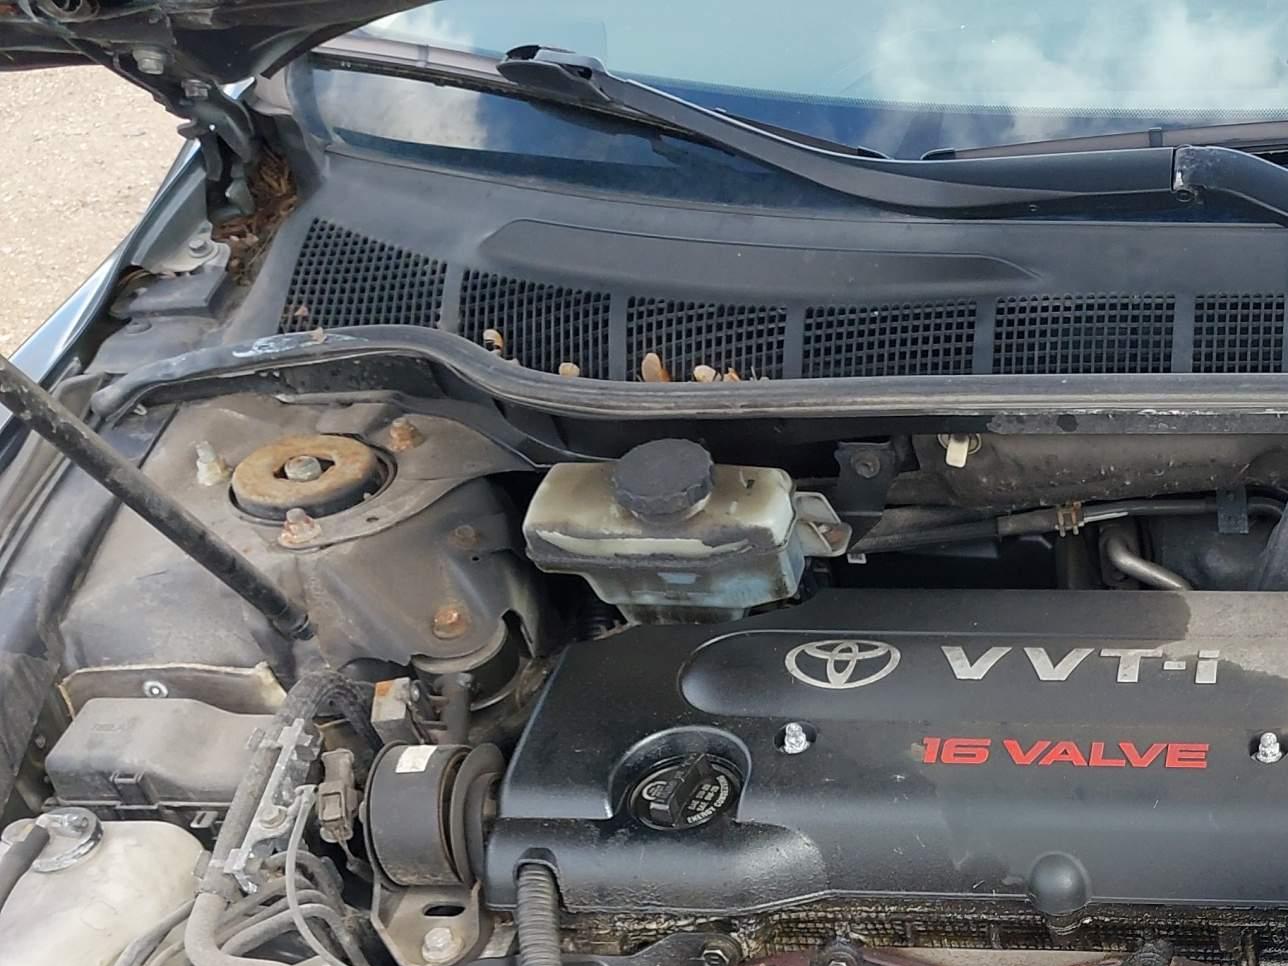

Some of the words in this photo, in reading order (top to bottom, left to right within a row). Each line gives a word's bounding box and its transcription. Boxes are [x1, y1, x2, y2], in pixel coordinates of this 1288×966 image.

[941, 646, 1219, 683] VVT-i
[922, 737, 992, 765] 16
[1003, 738, 1209, 768] VALVE
[686, 806, 716, 824] ENERGY
